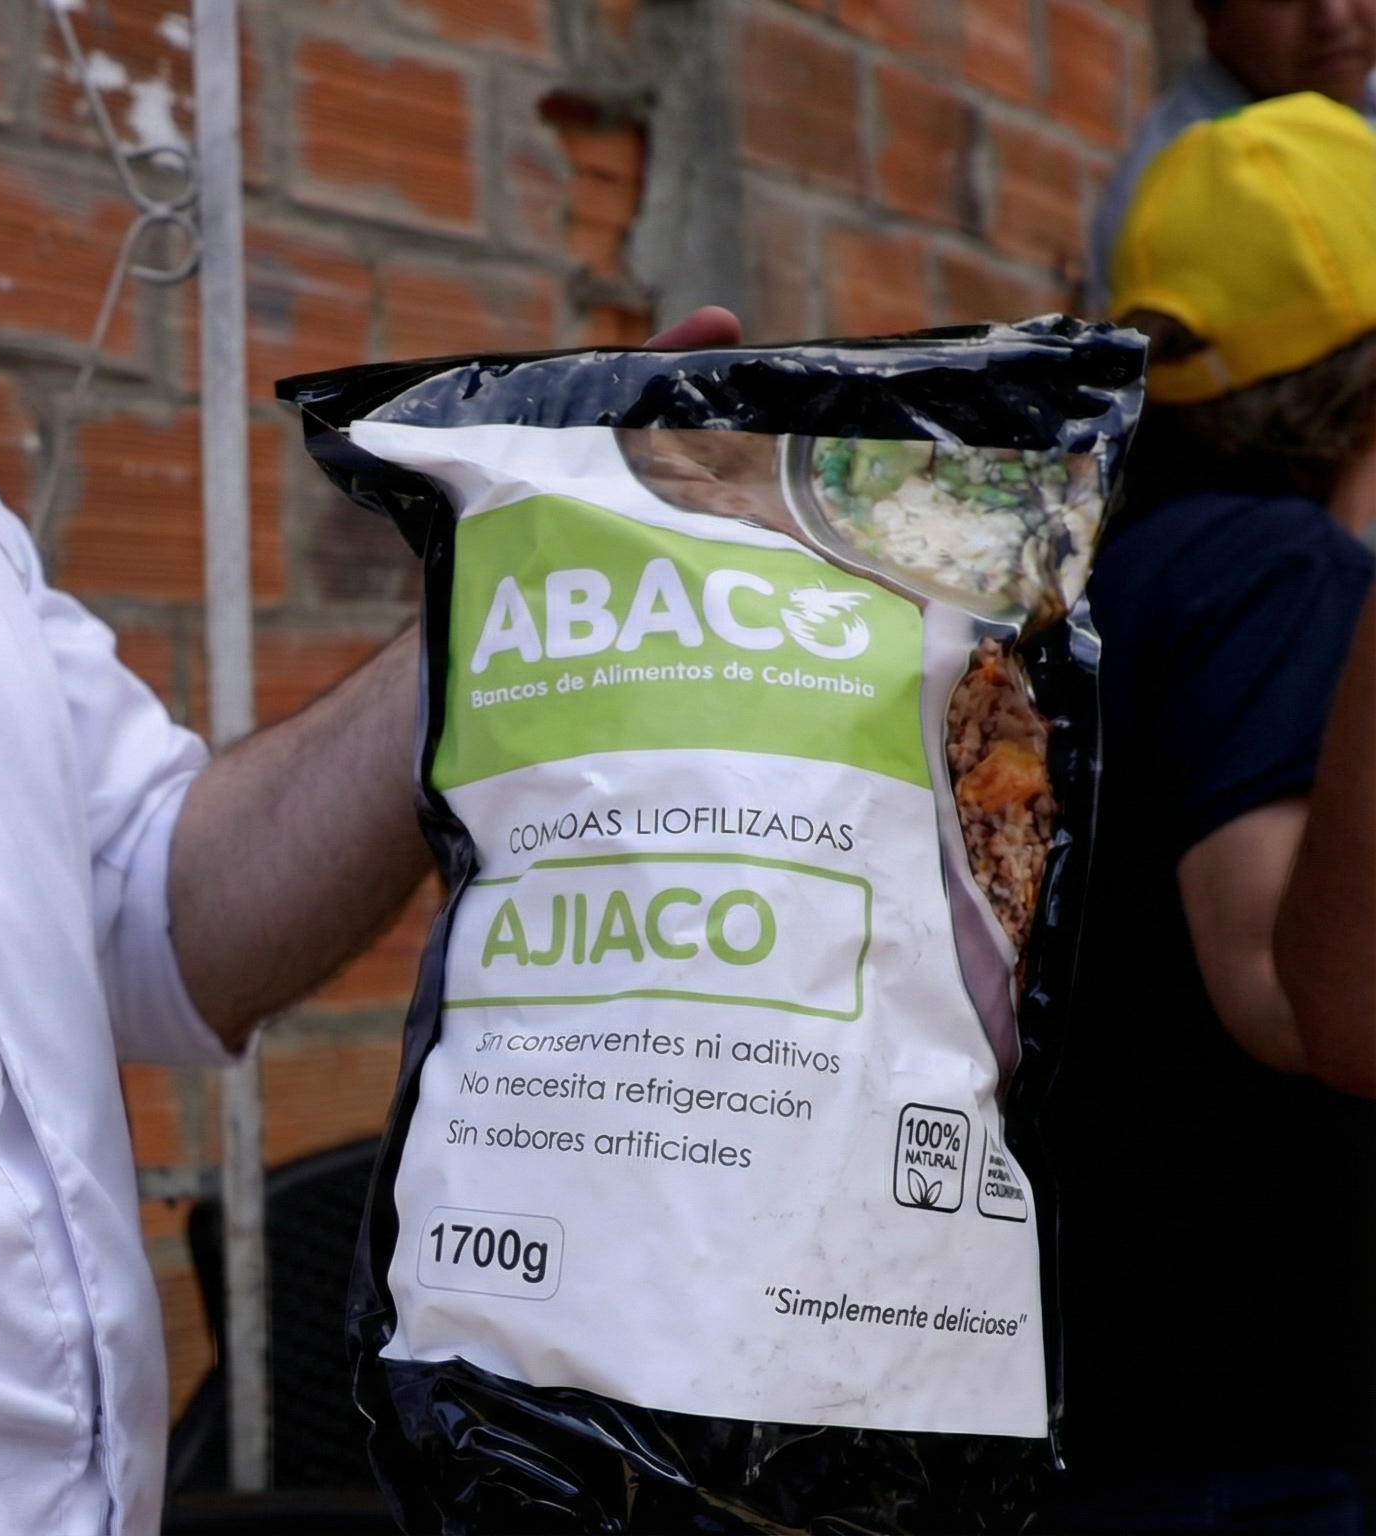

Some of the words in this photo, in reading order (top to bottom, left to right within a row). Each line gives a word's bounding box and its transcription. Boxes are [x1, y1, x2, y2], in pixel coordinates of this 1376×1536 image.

[470, 557, 872, 675] ABACO
[471, 679, 549, 709] Bancos
[556, 672, 585, 692] de
[592, 662, 714, 687] Alimentos
[723, 660, 754, 681] de
[762, 666, 876, 698] Colombia
[637, 807, 854, 851] LIOFILIZADAS
[481, 887, 777, 968] AJIACO
[475, 1032, 503, 1053] Sin
[506, 1028, 685, 1057] conserventes
[695, 1034, 721, 1060] ni
[731, 1039, 841, 1075] aditivos
[460, 1071, 490, 1095] No
[495, 1073, 606, 1101] necesita
[615, 1078, 813, 1121] refrigeración
[446, 1119, 478, 1146] Sin
[485, 1123, 585, 1153] sobores
[594, 1130, 753, 1168] artificiales
[906, 1117, 960, 1151] 100%
[905, 1149, 958, 1170] NATURAL
[430, 1222, 548, 1284] 1700g
